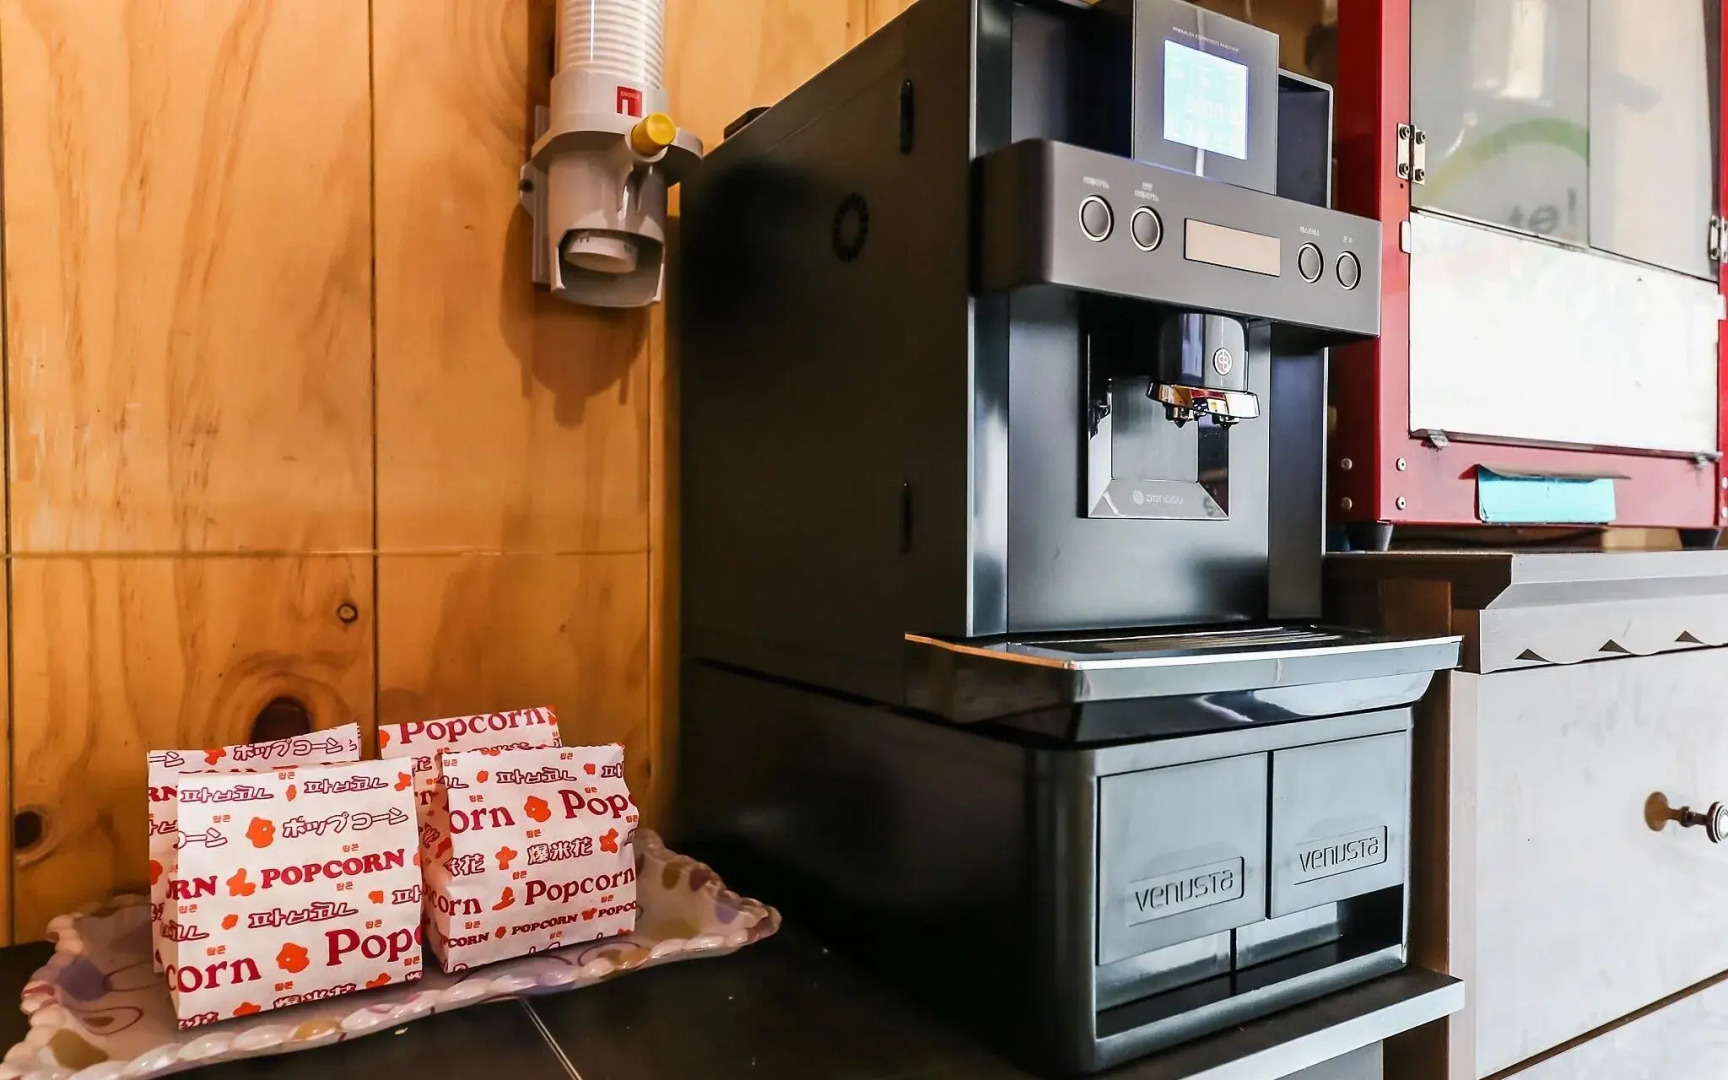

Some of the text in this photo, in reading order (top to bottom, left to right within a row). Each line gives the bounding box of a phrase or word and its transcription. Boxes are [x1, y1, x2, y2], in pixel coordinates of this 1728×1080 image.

[400, 708, 546, 745] Popcorn
[261, 848, 405, 889] POPCORN
[524, 867, 636, 907] Popcorn
[511, 913, 579, 936] POPCORN
